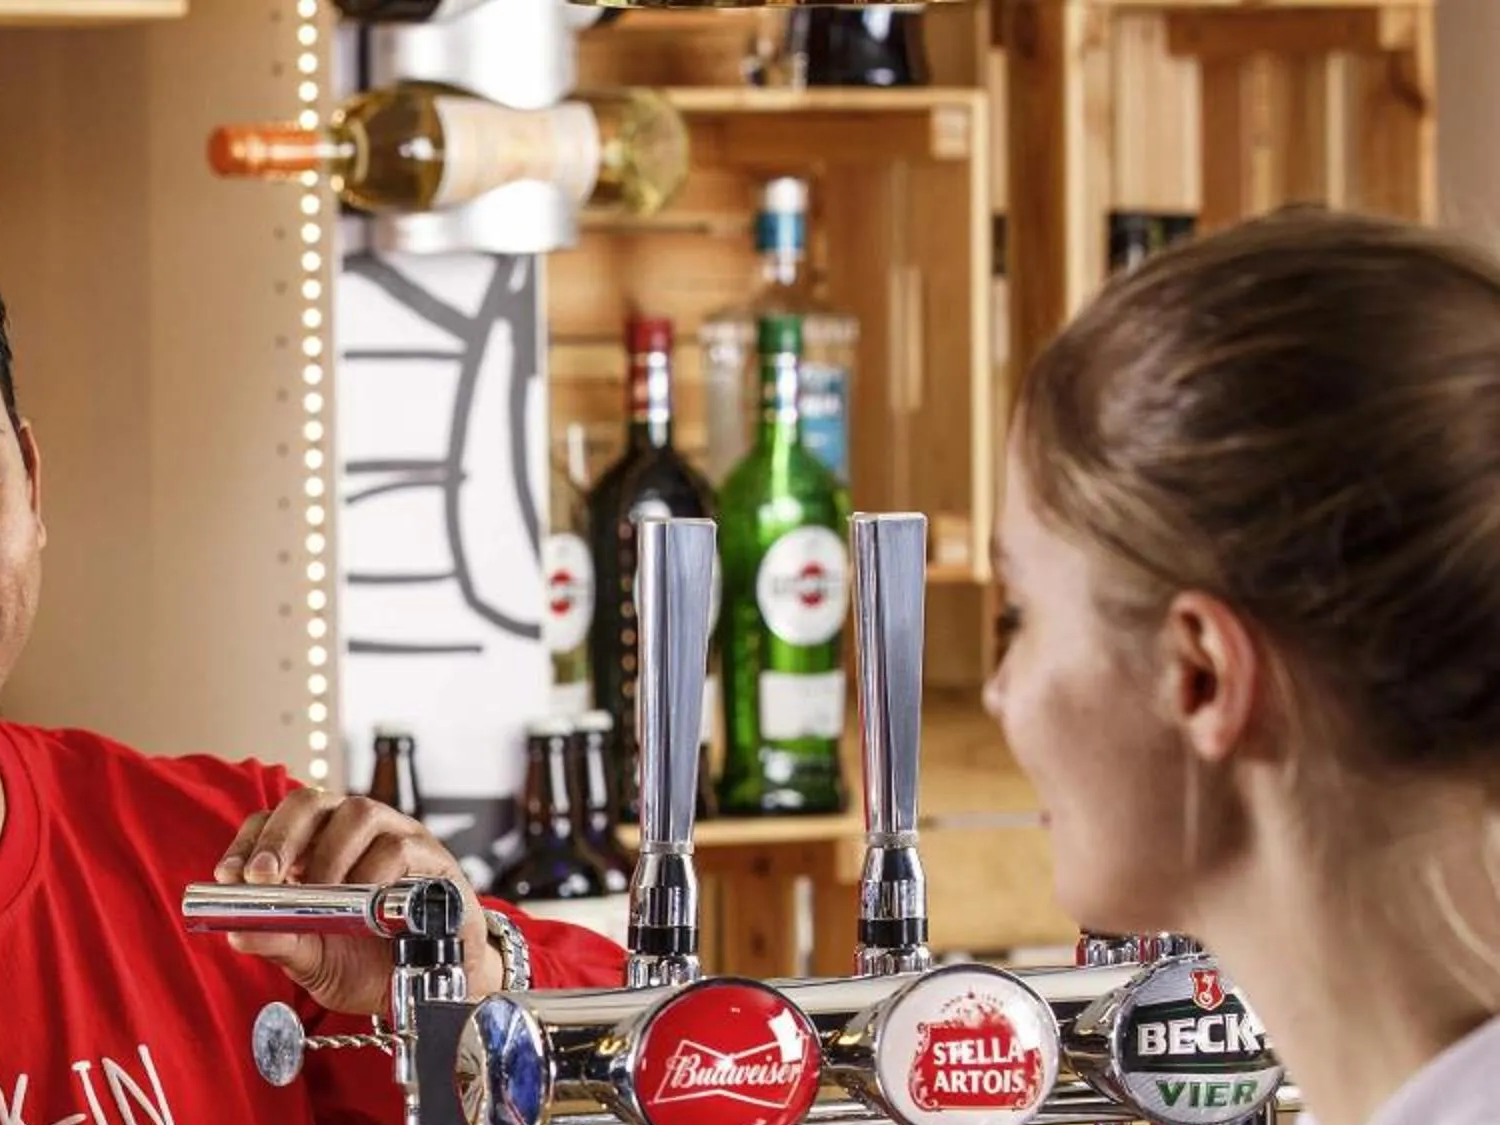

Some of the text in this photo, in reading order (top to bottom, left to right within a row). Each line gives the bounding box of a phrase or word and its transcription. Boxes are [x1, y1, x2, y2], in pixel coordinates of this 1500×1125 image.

[932, 1036, 1026, 1065] STELLA
[666, 1053, 804, 1089] Budweiser
[933, 1068, 1027, 1095] ARTOIS
[1156, 1079, 1258, 1108] VIER
